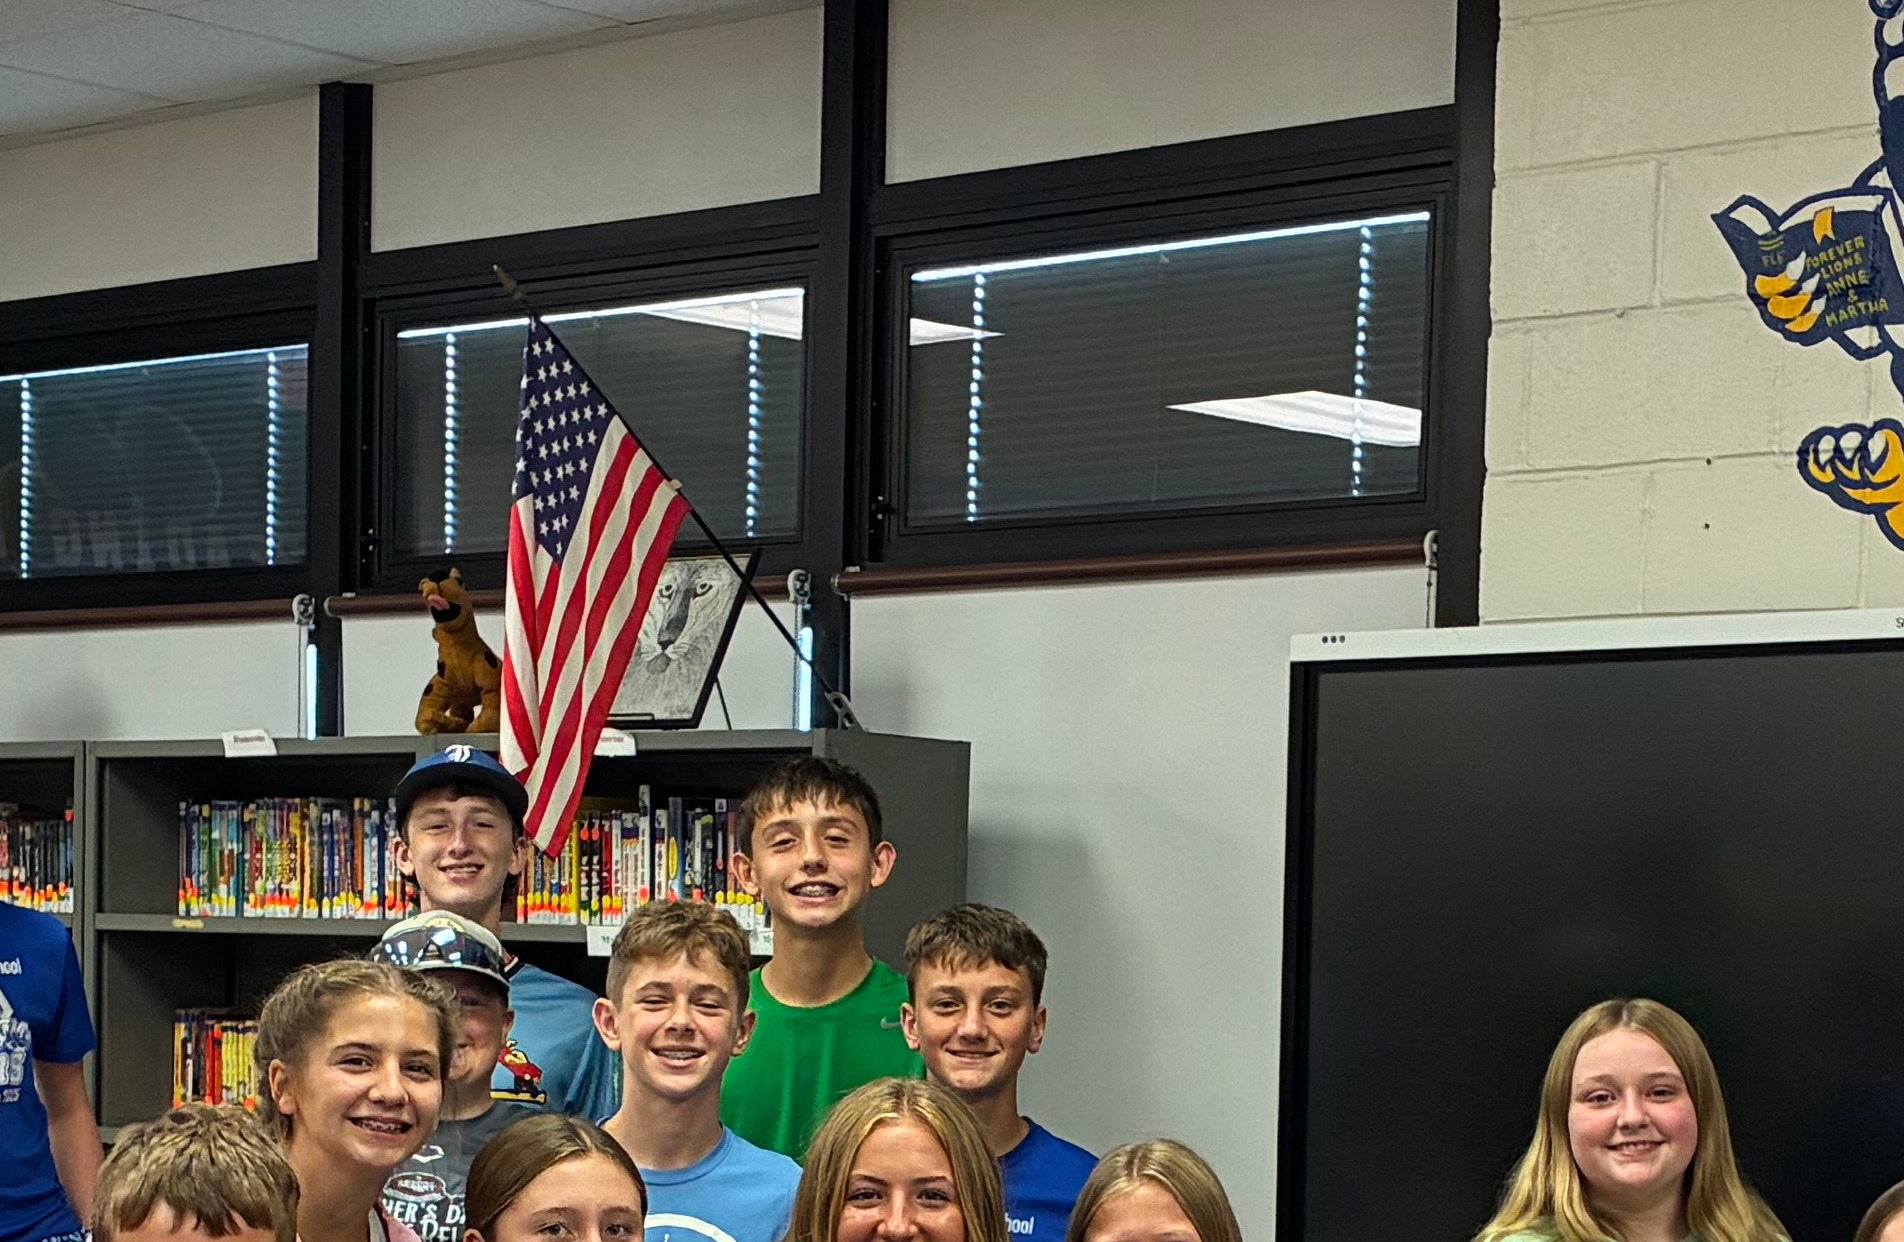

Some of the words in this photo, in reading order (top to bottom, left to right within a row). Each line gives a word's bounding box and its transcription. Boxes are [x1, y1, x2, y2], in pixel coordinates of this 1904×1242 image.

[1805, 236, 1866, 272] FOREVER
[1820, 254, 1864, 281] LIONS
[1825, 269, 1871, 298] ANNE
[1847, 288, 1859, 304] &
[1826, 298, 1890, 328] MARTHA
